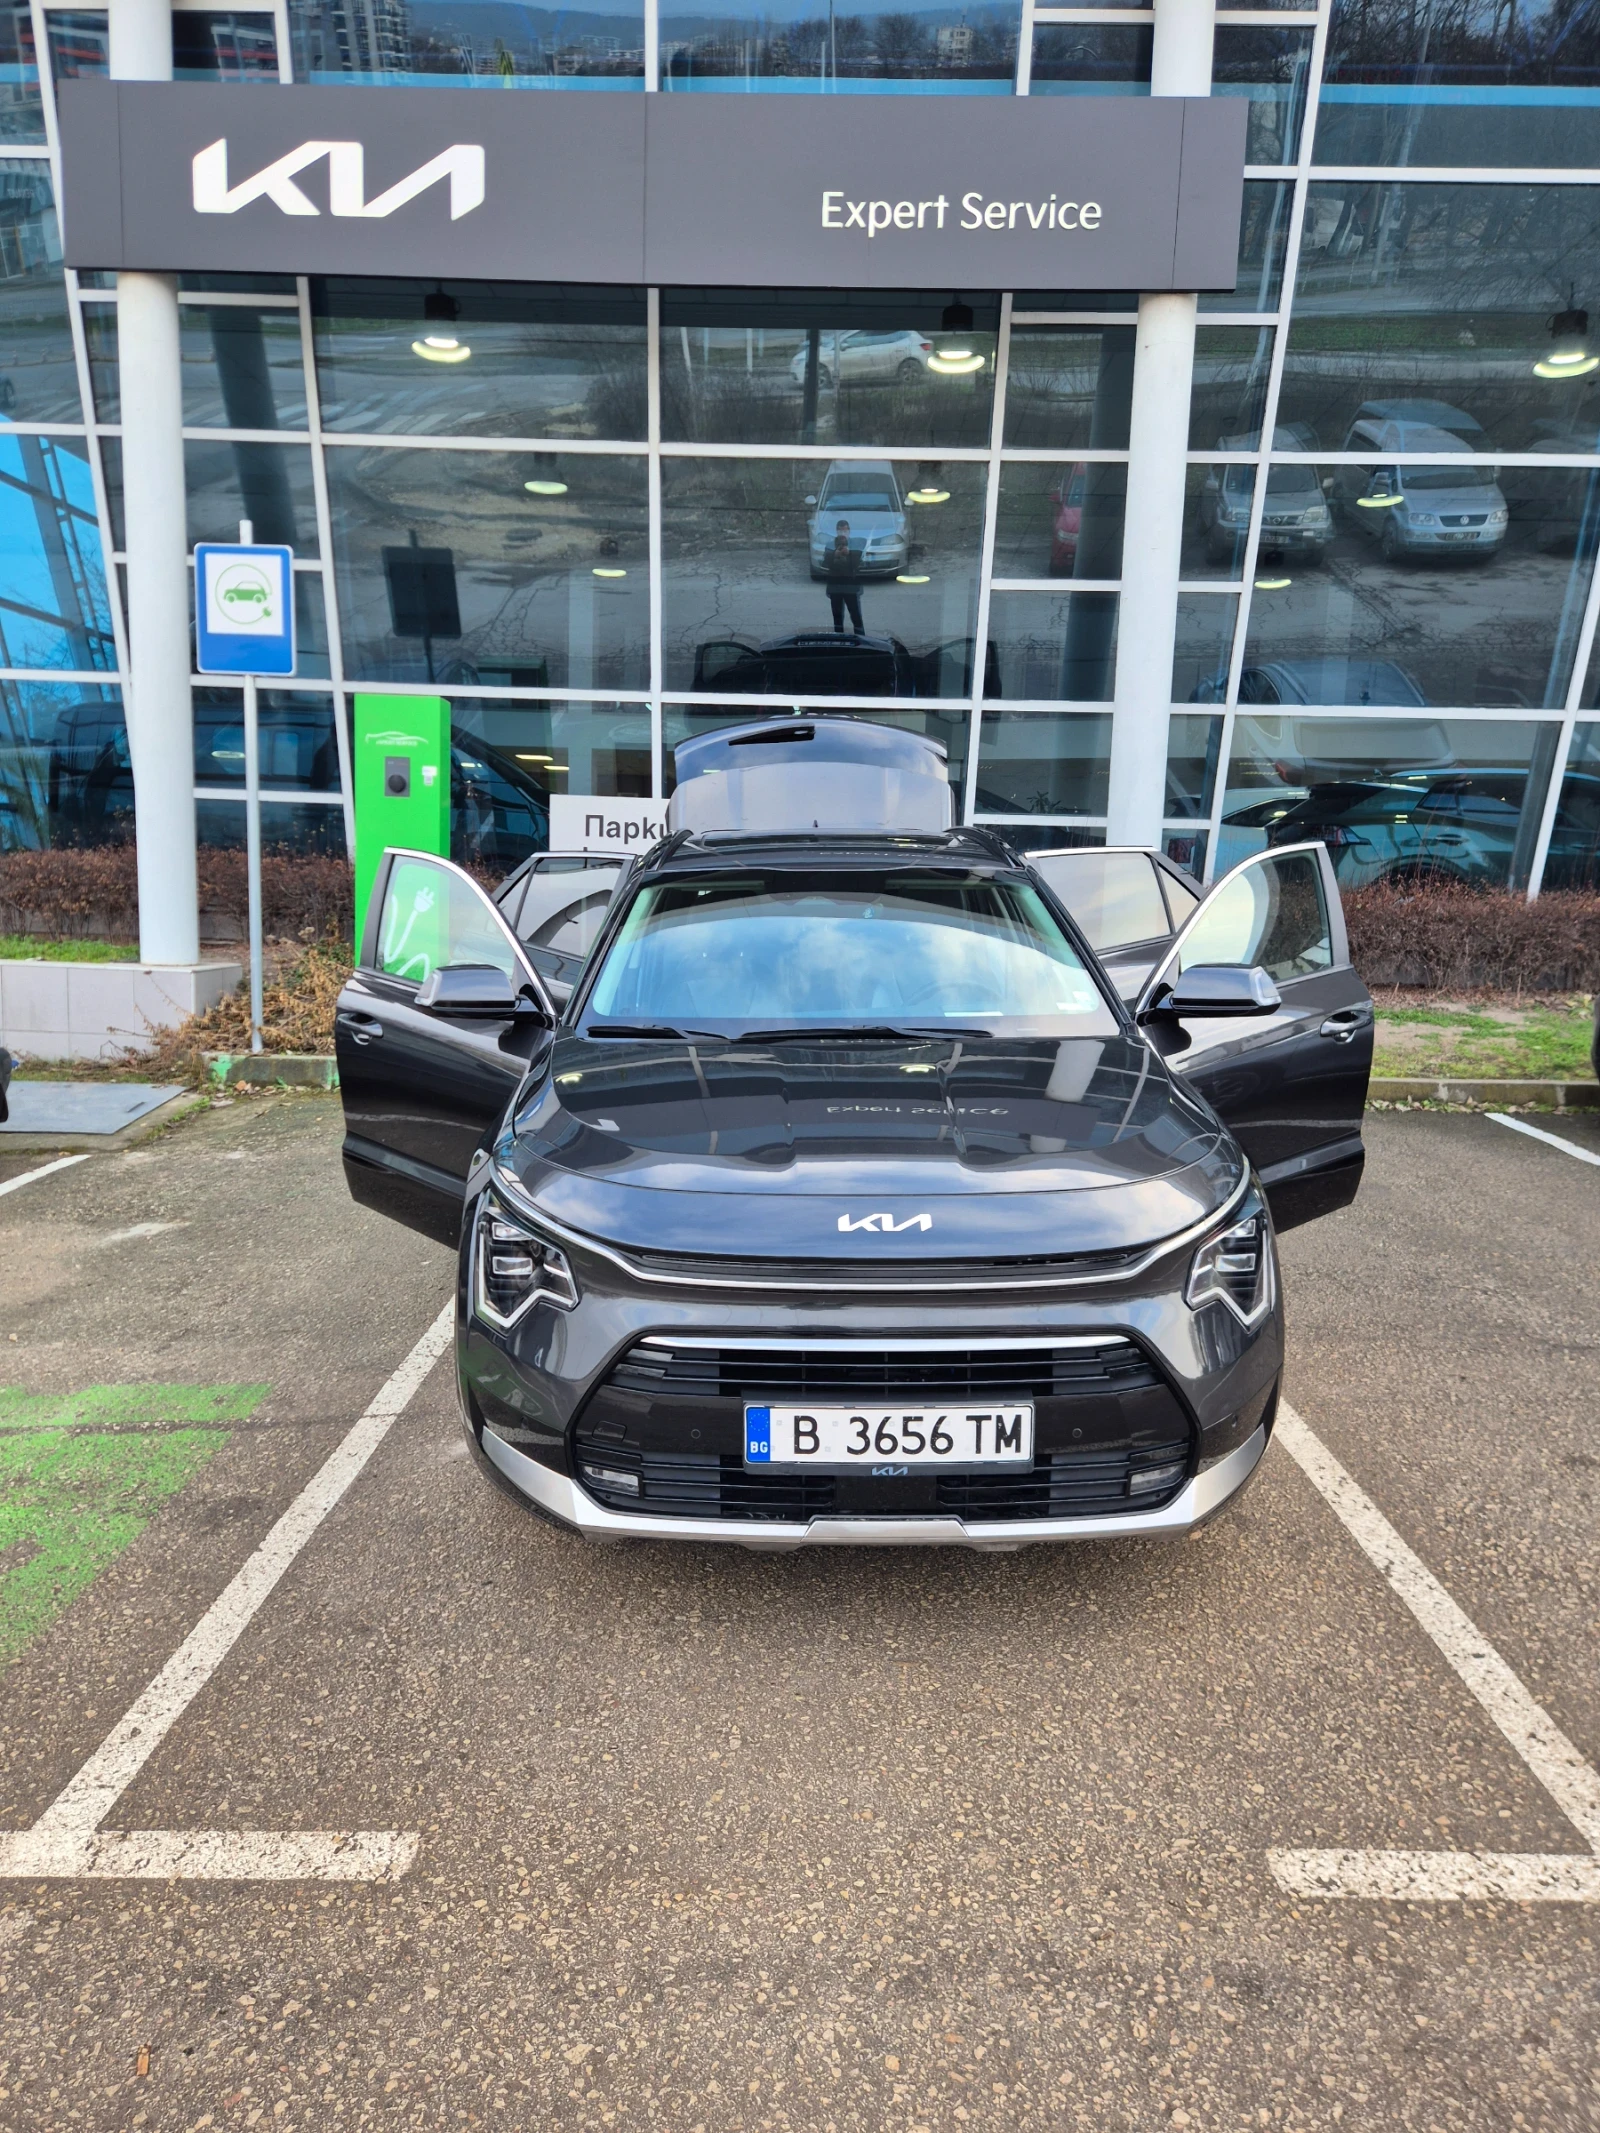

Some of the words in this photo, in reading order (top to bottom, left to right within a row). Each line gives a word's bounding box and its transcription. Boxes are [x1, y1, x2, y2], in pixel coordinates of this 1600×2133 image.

[822, 191, 949, 237] Expert
[960, 192, 1102, 229] Service
[750, 1441, 768, 1453] BG
[793, 1415, 820, 1454] B
[847, 1416, 954, 1455] 3656
[966, 1414, 1022, 1454] TM
